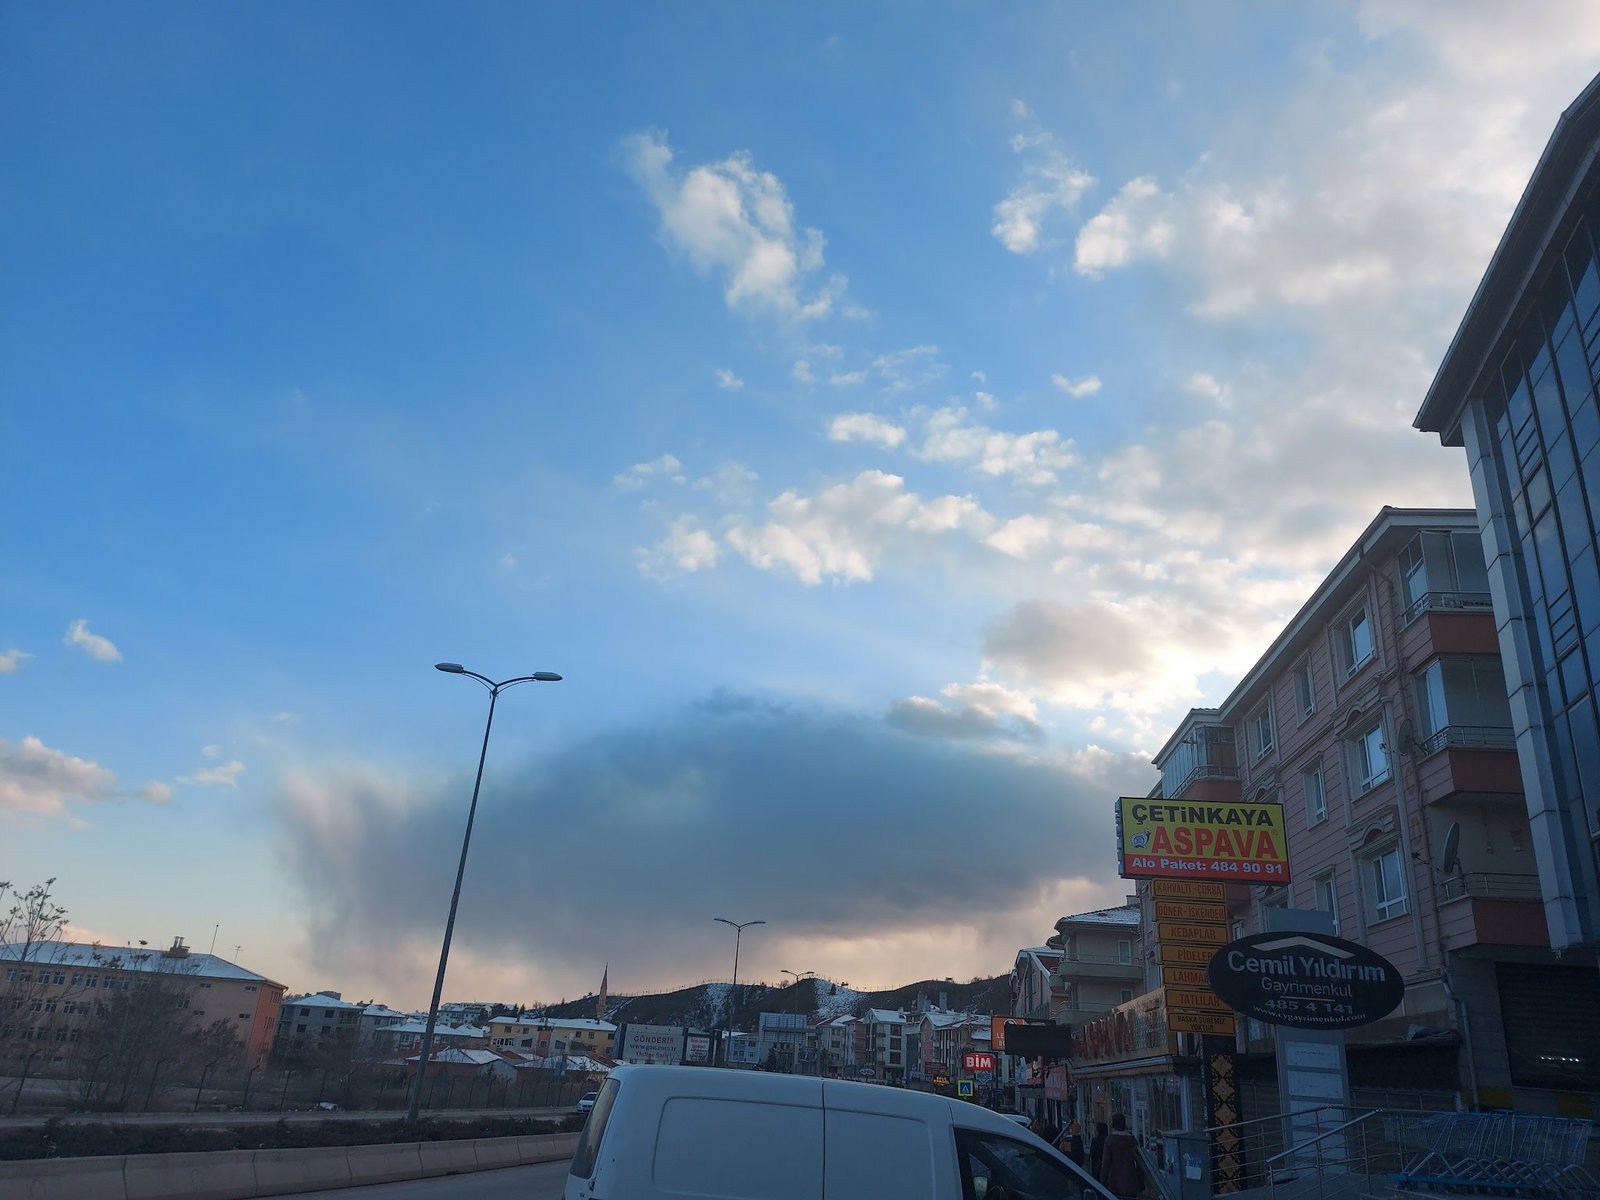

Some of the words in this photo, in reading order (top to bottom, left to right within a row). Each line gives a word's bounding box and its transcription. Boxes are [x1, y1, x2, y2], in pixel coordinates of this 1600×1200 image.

[1152, 826, 1278, 859] ASPAVA
[1132, 858, 1155, 868] Alo
[1160, 859, 1207, 871] Paket:
[1211, 861, 1238, 872] 484
[1243, 863, 1260, 874] 90
[1265, 864, 1283, 874] 91
[1157, 882, 1191, 894] KAHVALTI
[1171, 927, 1216, 939] KEBAPLAR
[1227, 950, 1296, 976] Cemil
[1299, 957, 1386, 982] Yıldırım
[1261, 977, 1353, 998] Gayrimenkul
[1265, 999, 1299, 1010] 485
[966, 1054, 992, 1068] BİM
